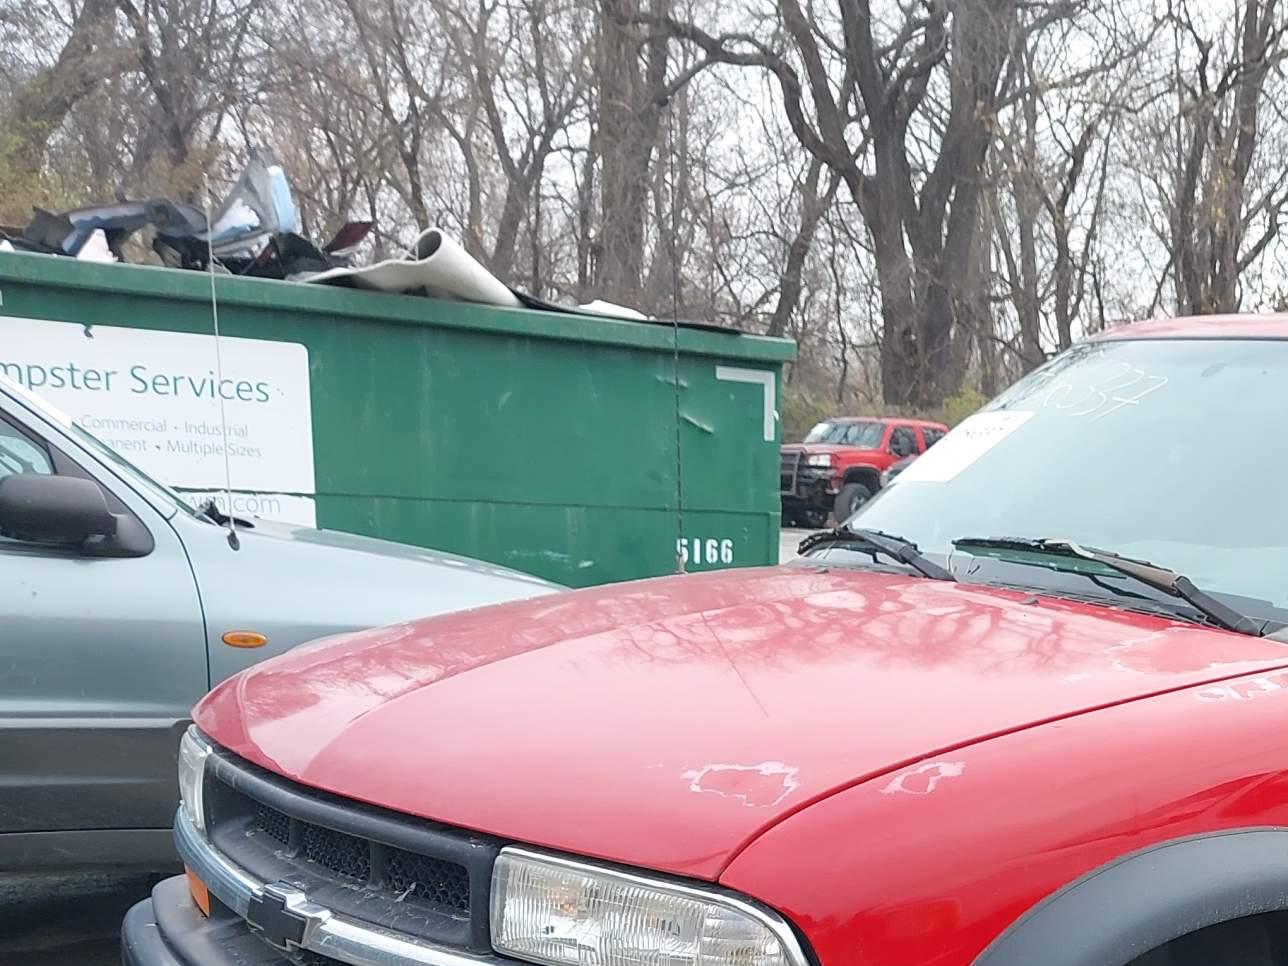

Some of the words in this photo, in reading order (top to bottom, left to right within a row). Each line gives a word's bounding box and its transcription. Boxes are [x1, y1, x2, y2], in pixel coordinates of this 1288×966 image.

[131, 365, 270, 403] Services
[80, 414, 168, 433] Commercial
[185, 420, 248, 438] Indusrial
[167, 440, 223, 457] Multiple
[227, 442, 262, 457] Sizes
[676, 538, 733, 564] 5166
